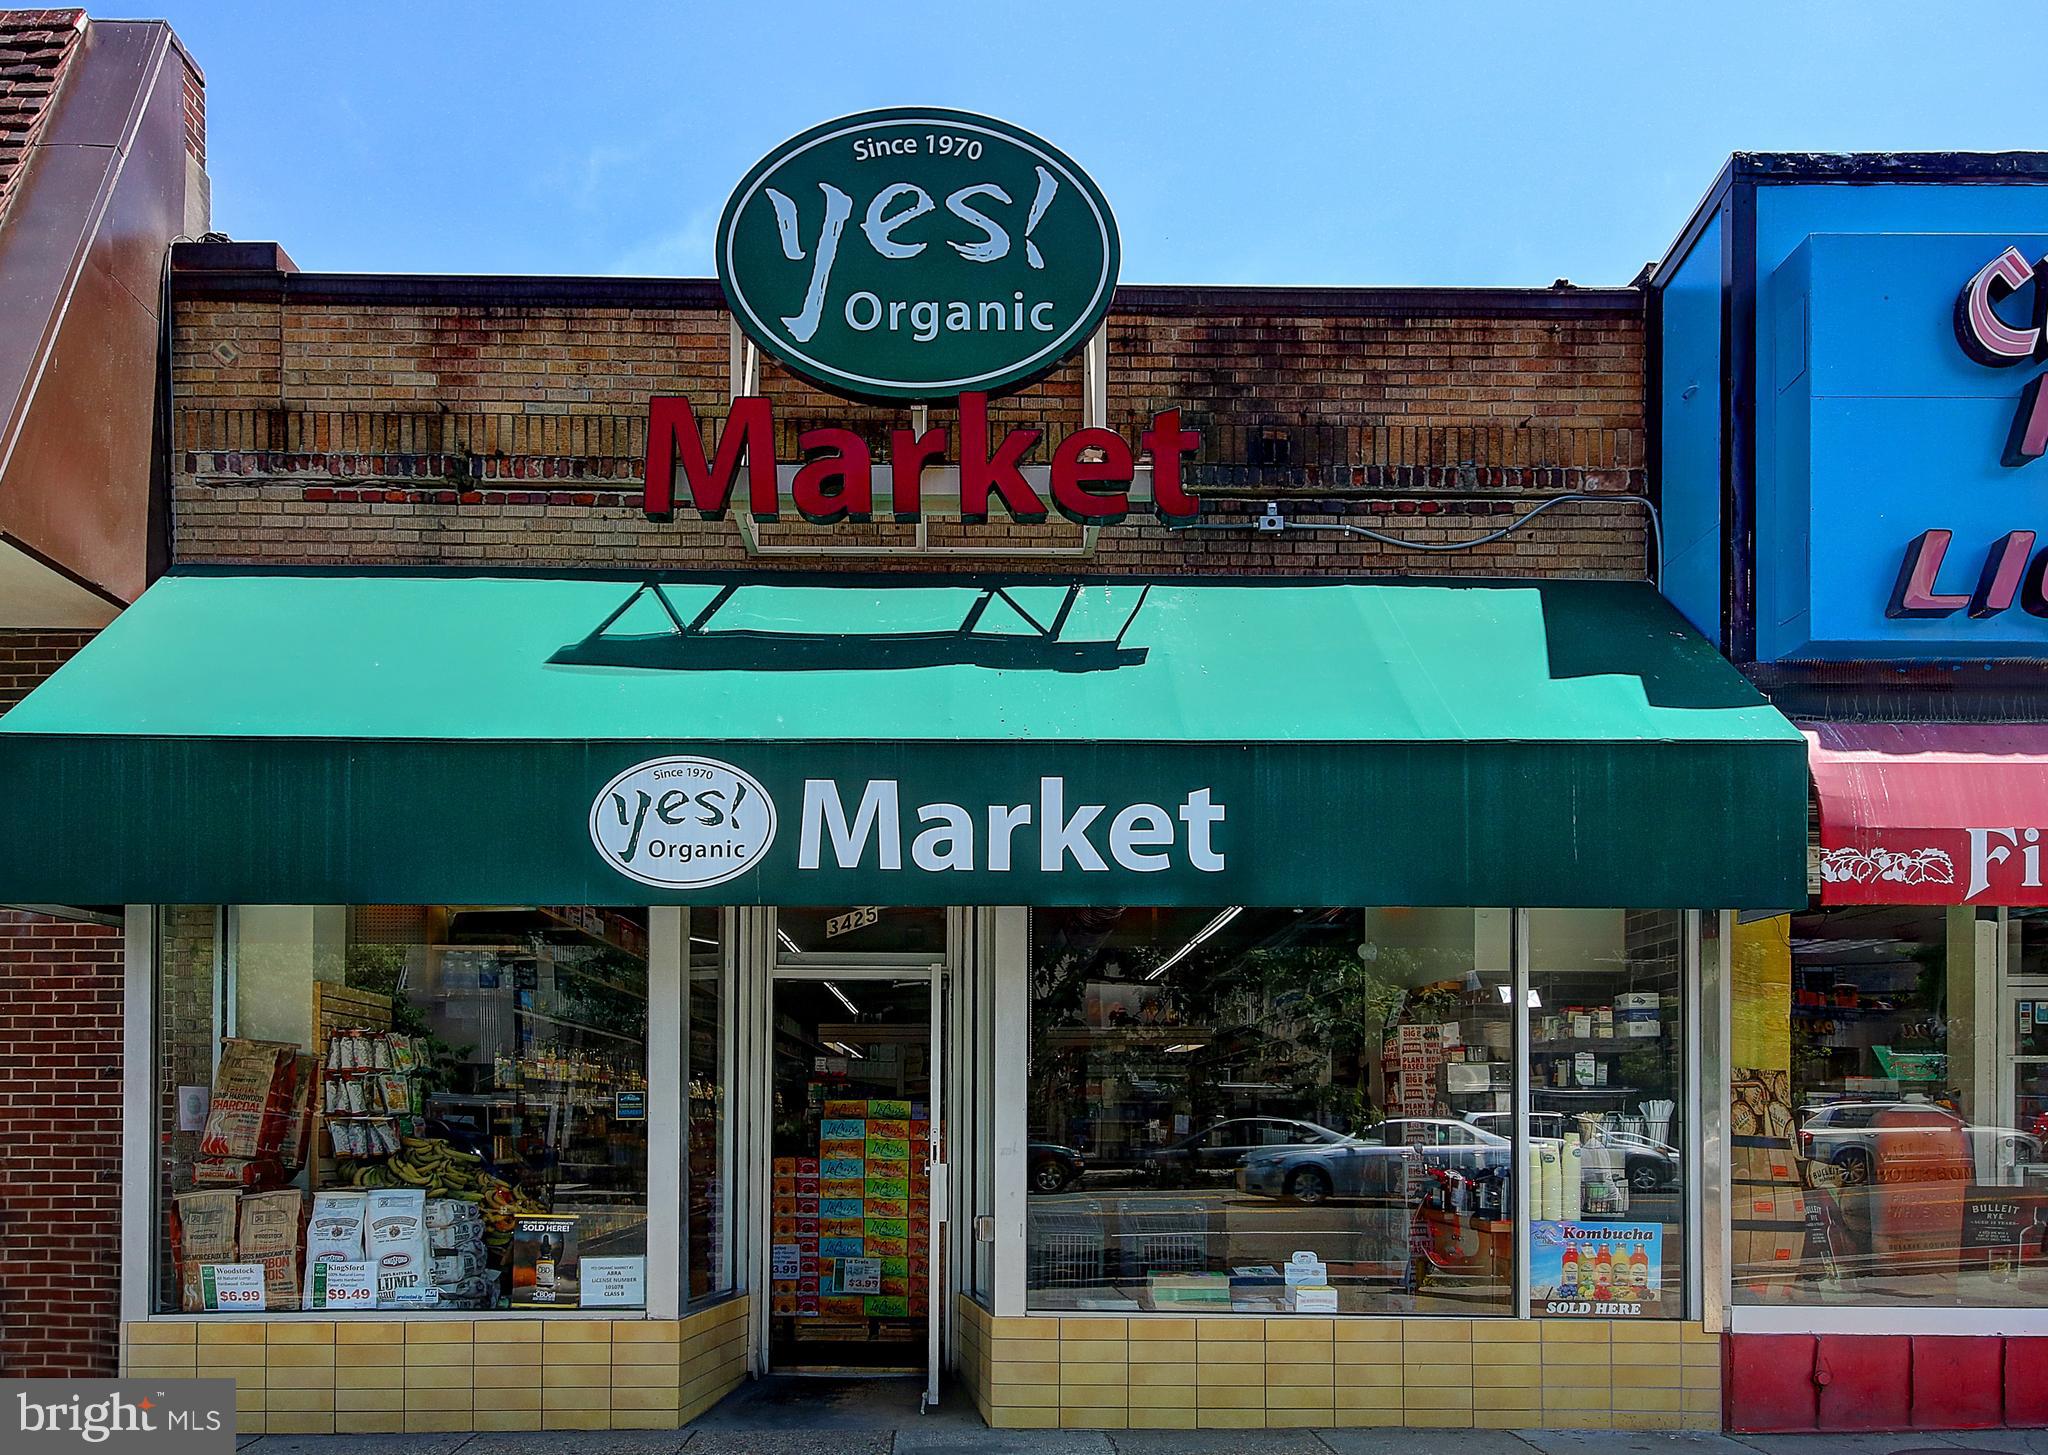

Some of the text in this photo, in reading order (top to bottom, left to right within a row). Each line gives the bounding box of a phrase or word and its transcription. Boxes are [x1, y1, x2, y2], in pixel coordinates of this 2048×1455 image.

[853, 133, 984, 162] Since 1970
[845, 291, 1055, 341] Organic
[643, 391, 1202, 525] Market
[653, 766, 714, 781] Since 1970
[798, 776, 1226, 873] Market
[648, 838, 746, 862] Organic
[828, 906, 877, 935] 3425
[1812, 1165, 1840, 1179] BULLEIT
[1971, 1204, 2020, 1215] BULLEIT
[522, 1224, 570, 1232] SOLD HERE!
[1562, 1226, 1654, 1240] Kombucha
[328, 1264, 365, 1272] KingSford
[377, 1273, 419, 1291] LUMP
[847, 1278, 879, 1289] $3.99
[219, 1290, 260, 1303] $6.99
[327, 1288, 371, 1302] $9.49
[1546, 1302, 1642, 1315] SOLD HERE
